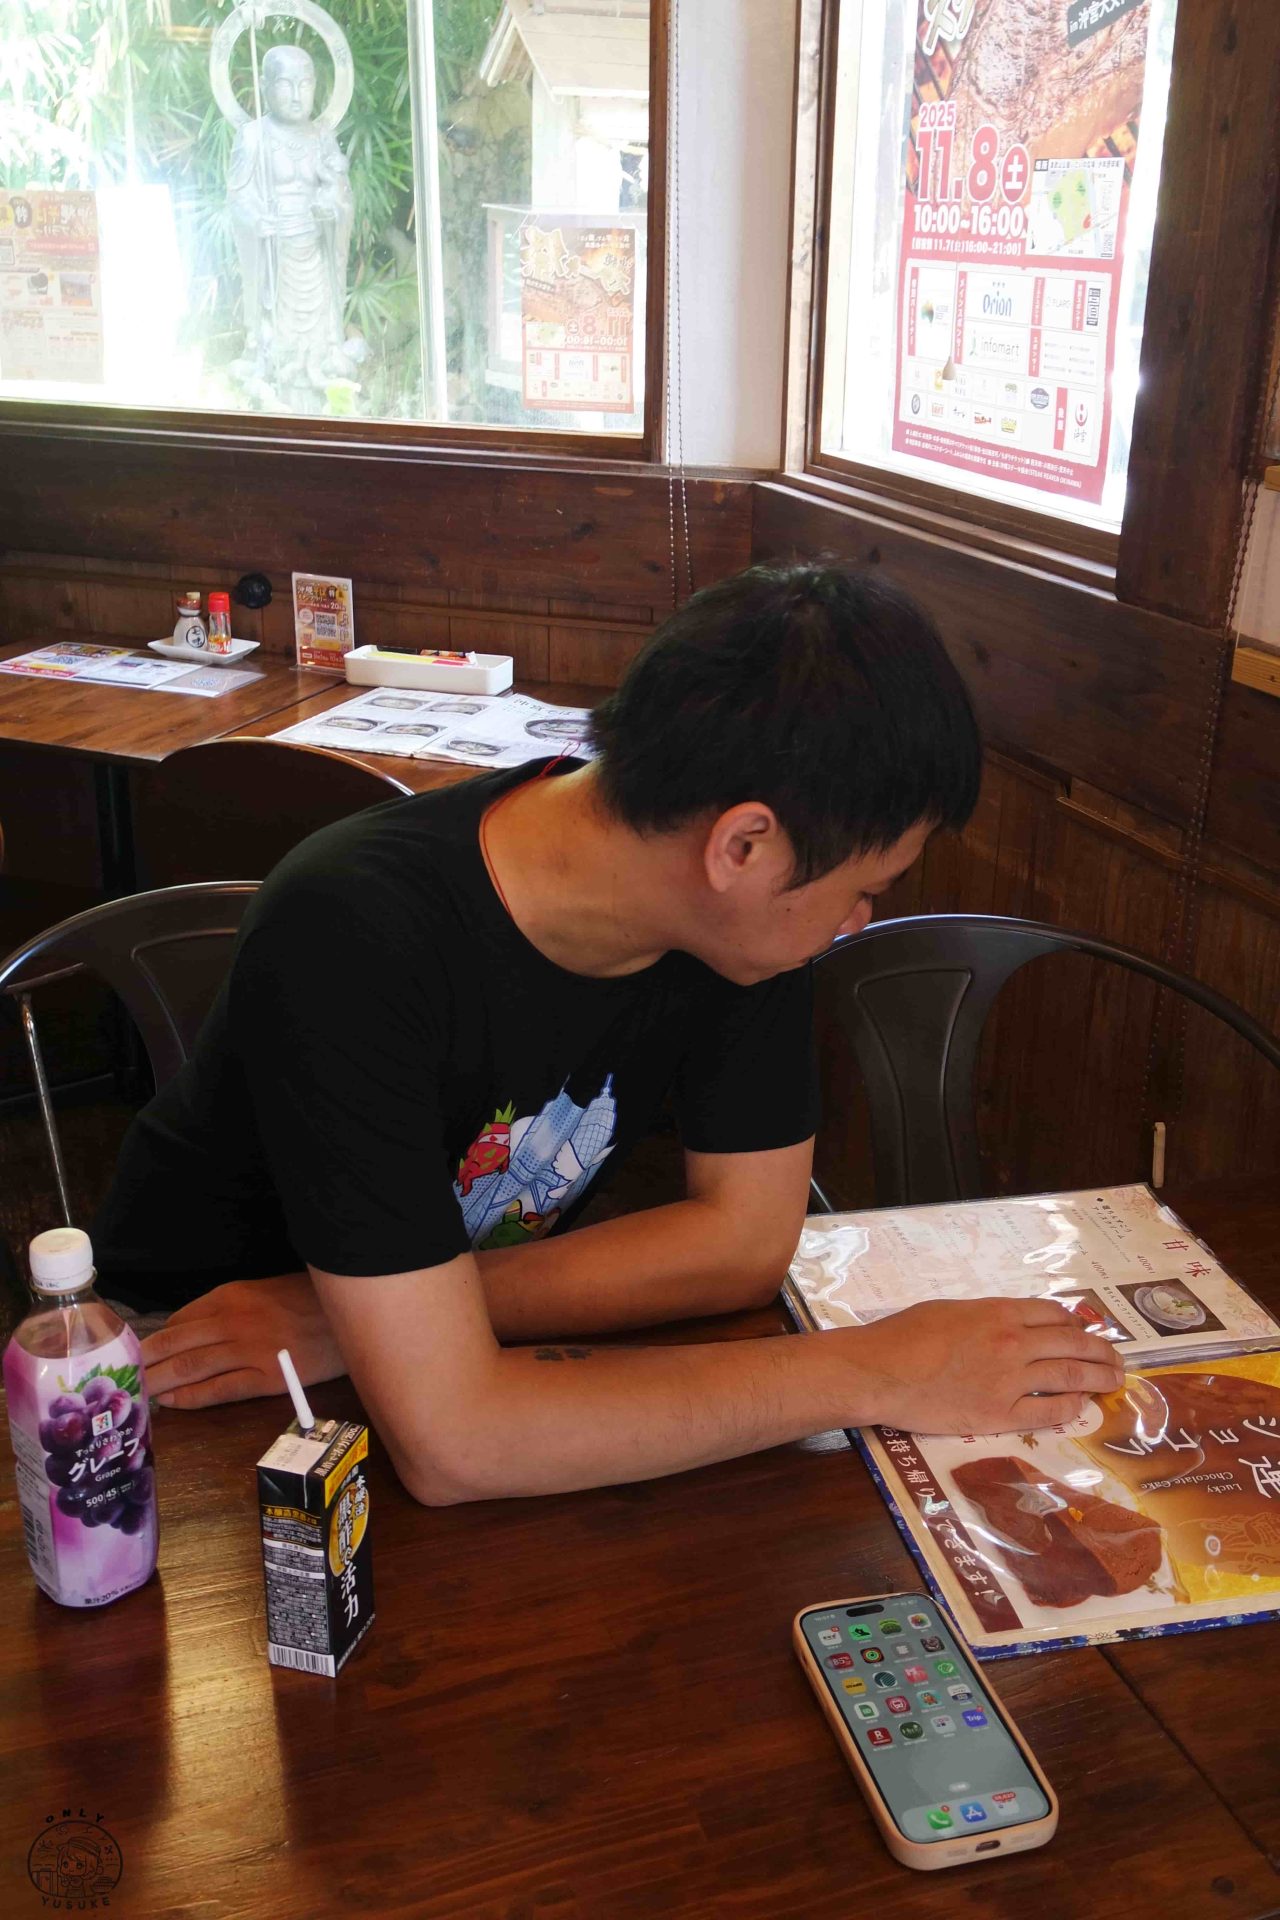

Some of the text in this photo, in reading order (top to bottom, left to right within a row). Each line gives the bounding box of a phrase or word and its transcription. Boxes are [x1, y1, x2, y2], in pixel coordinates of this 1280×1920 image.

[919, 103, 956, 128] 2025
[917, 126, 999, 202] 11.8
[981, 337, 1020, 358] infomart
[1162, 1239, 1212, 1277] 甘味
[68, 1432, 142, 1483] グレープ
[94, 1466, 122, 1482] Grape
[1140, 1470, 1234, 1490] Chocolate Cake
[1206, 1482, 1243, 1494] Lucky
